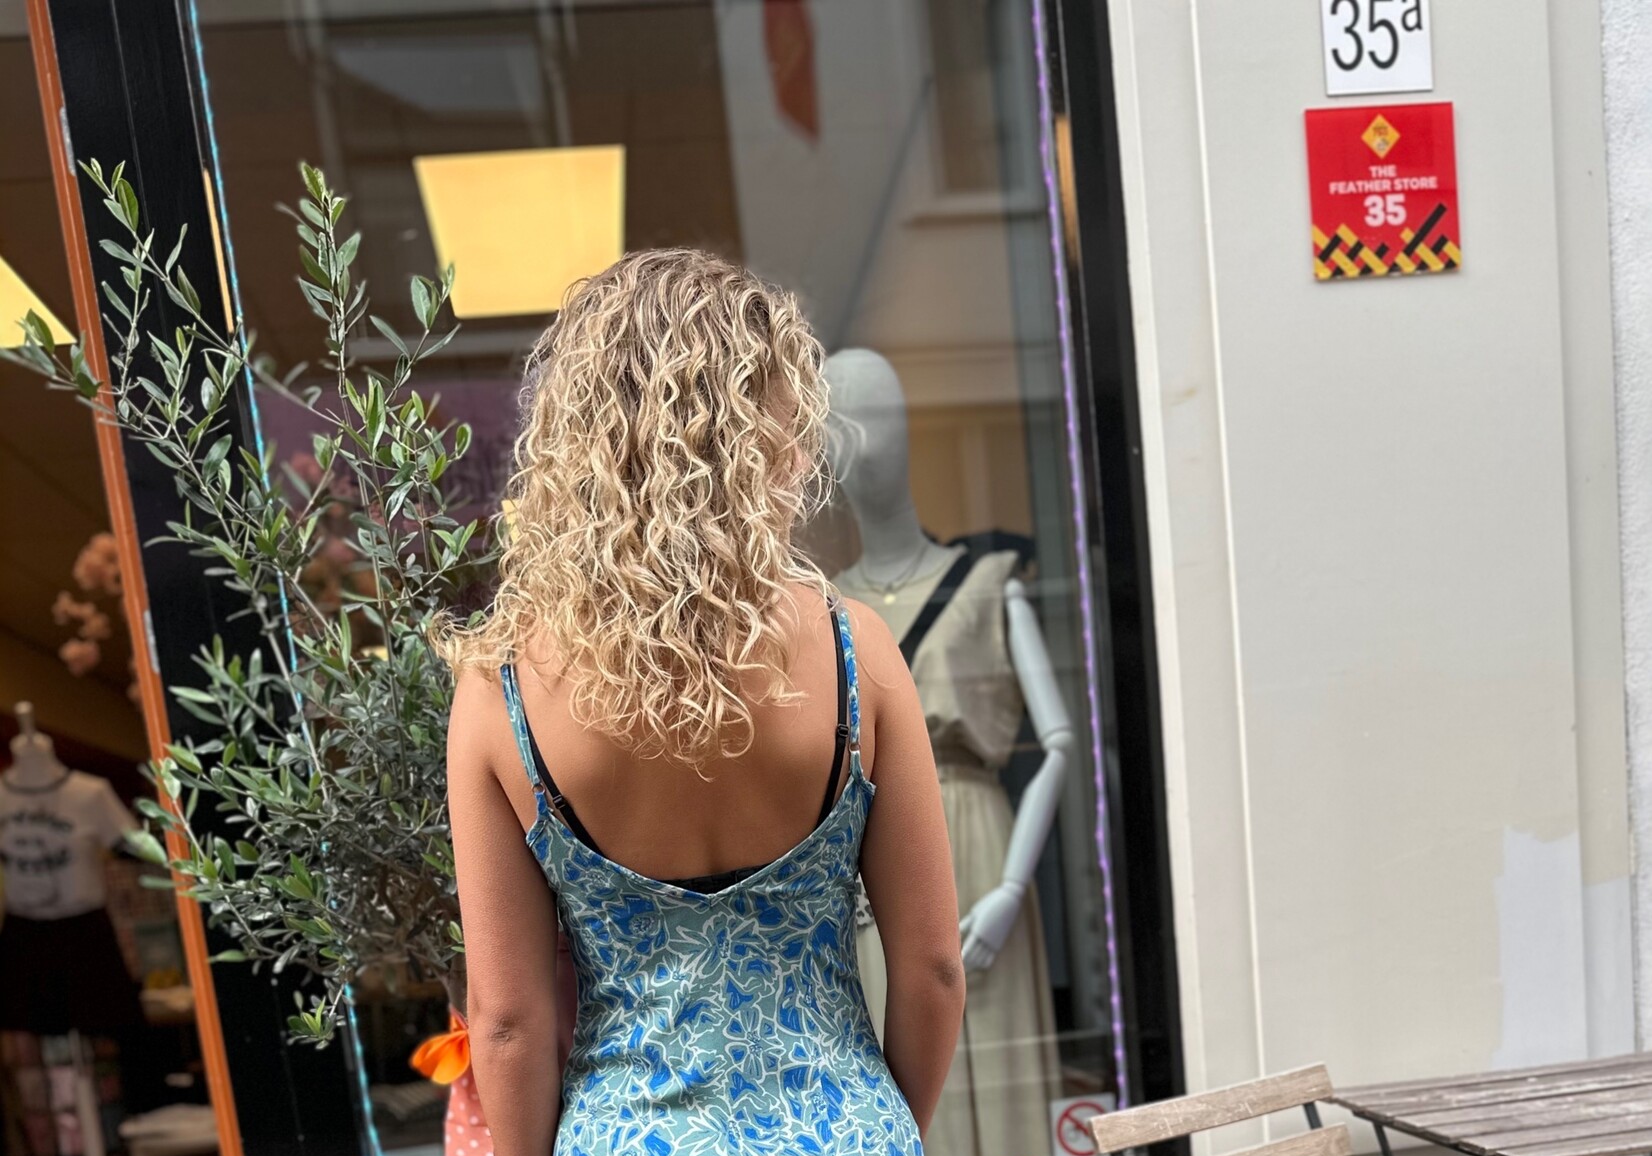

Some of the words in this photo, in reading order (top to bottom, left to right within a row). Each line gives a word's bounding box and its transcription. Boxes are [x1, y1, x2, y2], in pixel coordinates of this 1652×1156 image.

[1330, 0, 1423, 71] 35a
[1369, 165, 1397, 179] THE
[1329, 180, 1392, 195] FEATHER
[1394, 177, 1438, 191] STORE
[1364, 194, 1407, 227] 35
